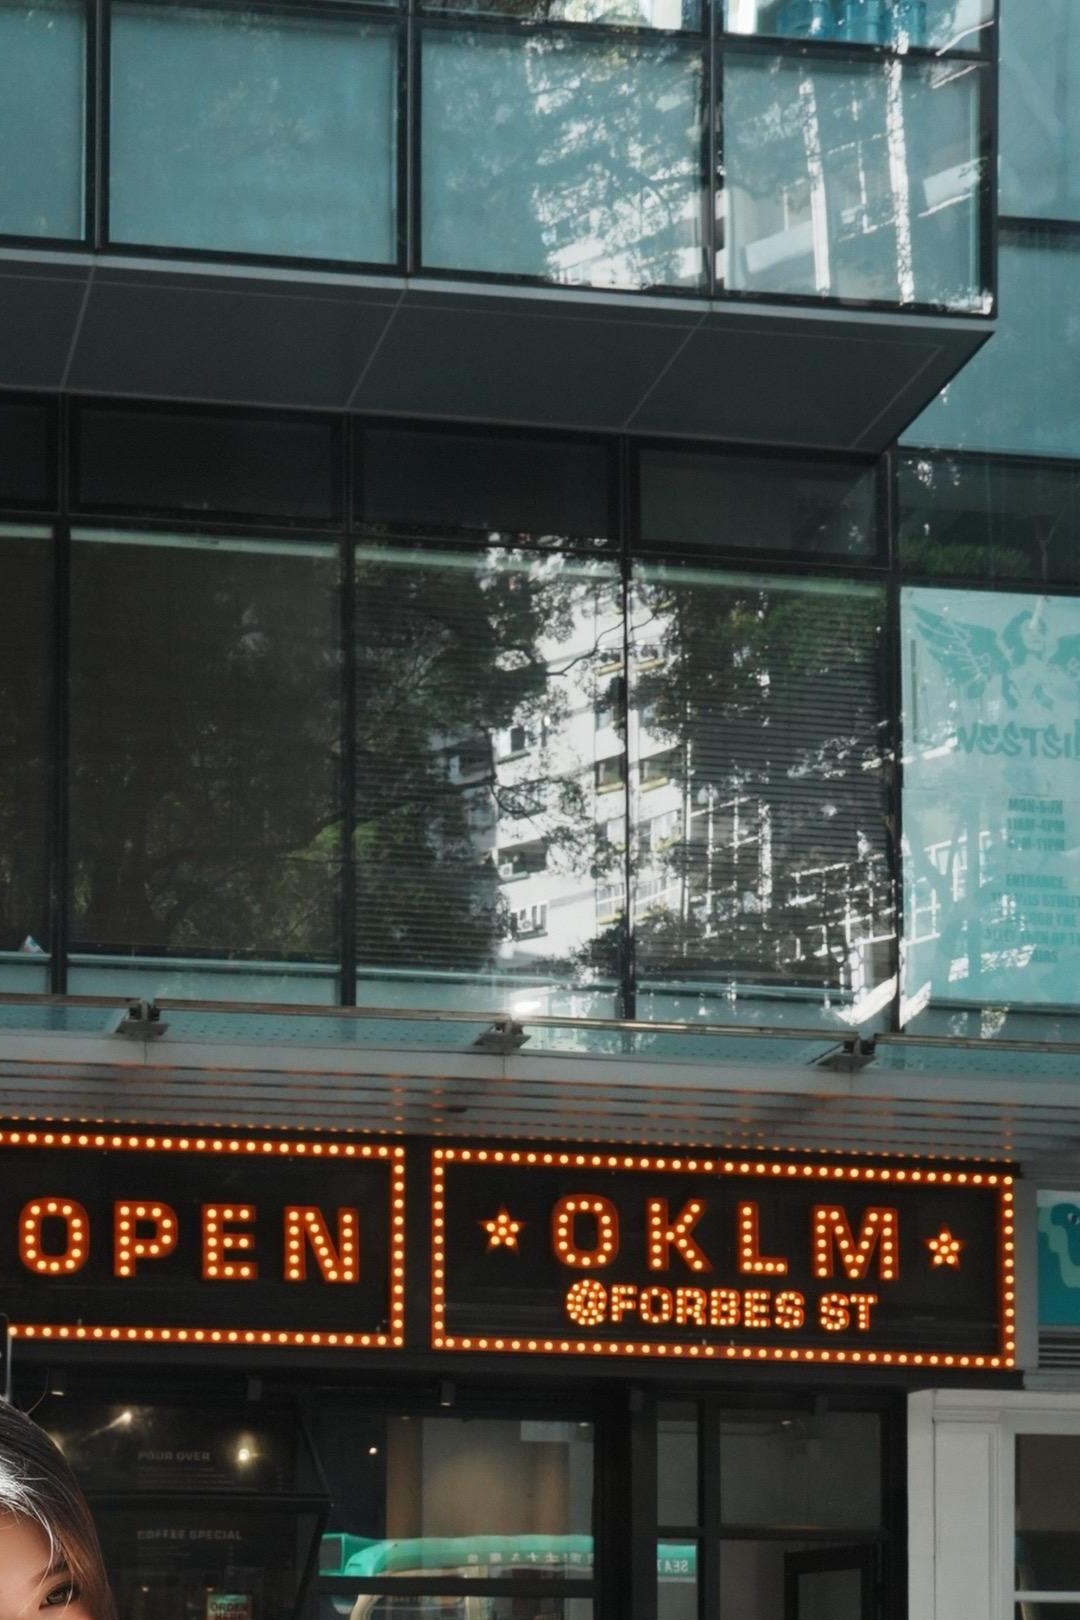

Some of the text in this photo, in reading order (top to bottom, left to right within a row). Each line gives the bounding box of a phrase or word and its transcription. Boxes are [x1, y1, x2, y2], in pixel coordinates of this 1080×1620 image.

[18, 1196, 361, 1283] OPEN
[552, 1193, 899, 1280] OKLM
[565, 1279, 878, 1331] @FORBES ST
[189, 1530, 243, 1541] SPECIAL
